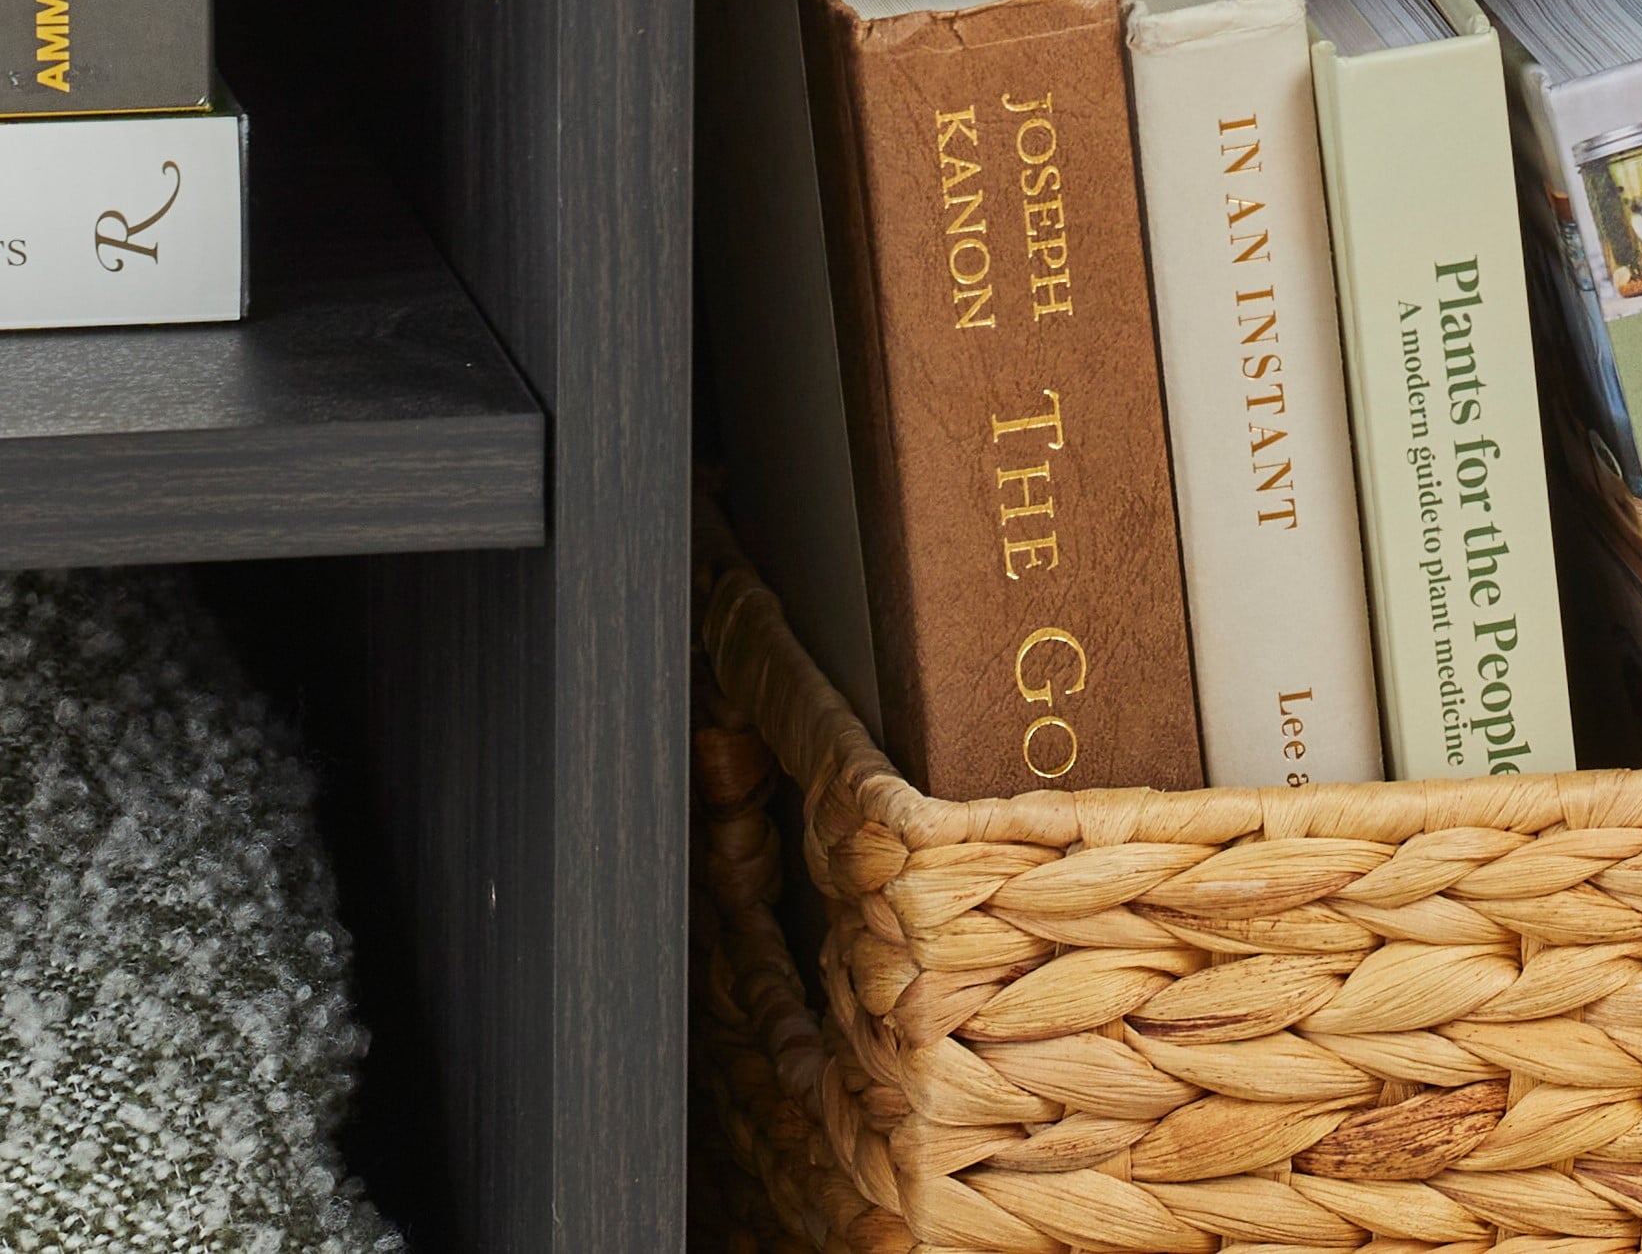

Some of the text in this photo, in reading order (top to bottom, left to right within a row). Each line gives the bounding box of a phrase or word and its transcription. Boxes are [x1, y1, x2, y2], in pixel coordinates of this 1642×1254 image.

[94, 159, 181, 274] R
[935, 105, 996, 330] KANON
[1001, 92, 1073, 322] JOSEPH
[1218, 113, 1298, 531] IN AN INSTANT
[1434, 254, 1487, 425] Plants
[1398, 299, 1469, 767] A modern guide to plant medicine
[1453, 434, 1501, 513] for
[1463, 520, 1510, 607] the
[991, 389, 1088, 779] THE GO
[1279, 687, 1312, 760] Lee
